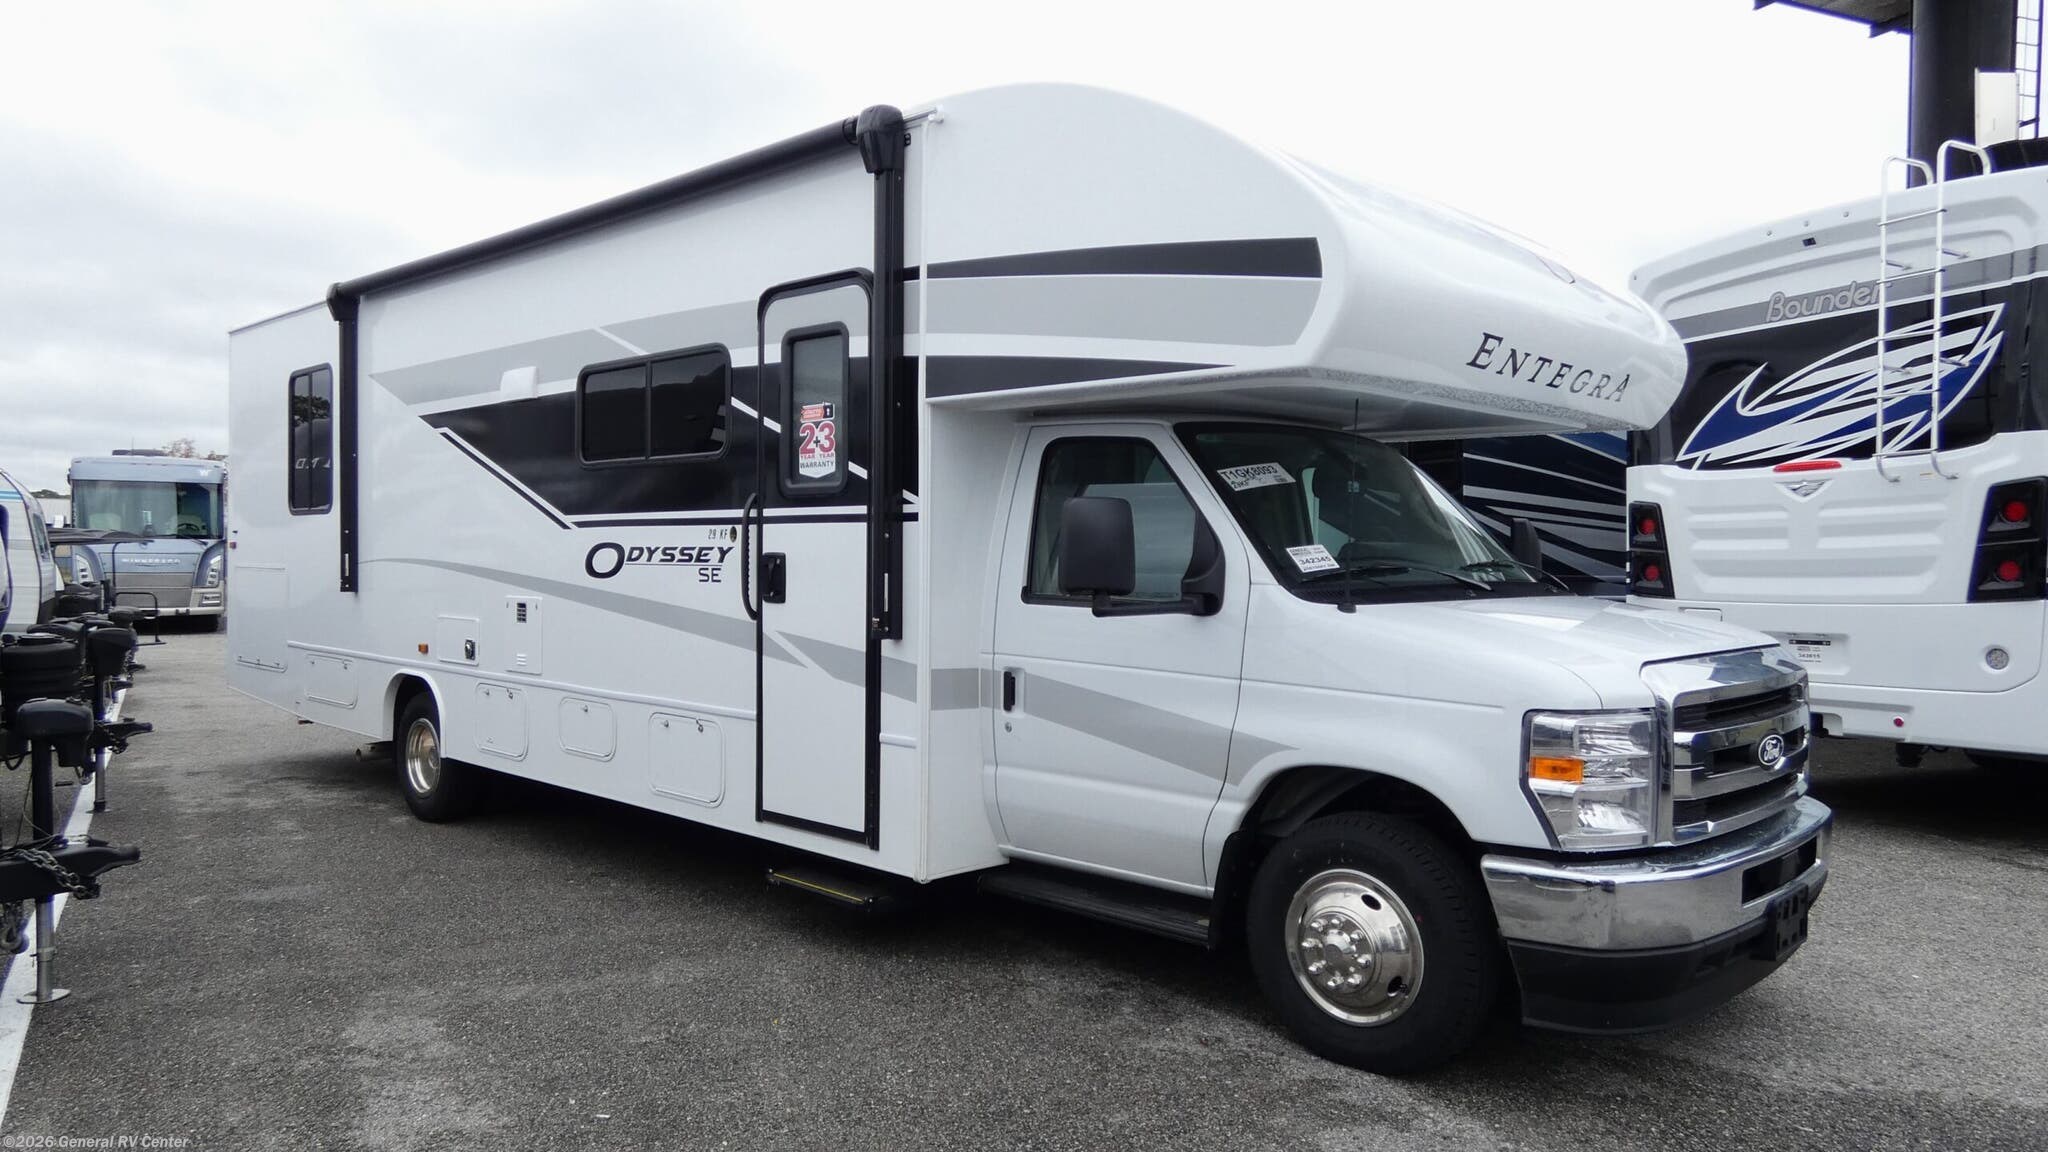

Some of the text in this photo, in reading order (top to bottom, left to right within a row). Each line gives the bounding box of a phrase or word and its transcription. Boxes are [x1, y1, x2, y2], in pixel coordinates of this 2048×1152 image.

[1765, 282, 1893, 323] Bounder
[1465, 332, 1632, 402] ENTEGRA
[800, 461, 834, 469] WARRANTY
[708, 529, 717, 540] 29
[585, 541, 735, 579] ODYSSEY
[698, 567, 722, 583] SE
